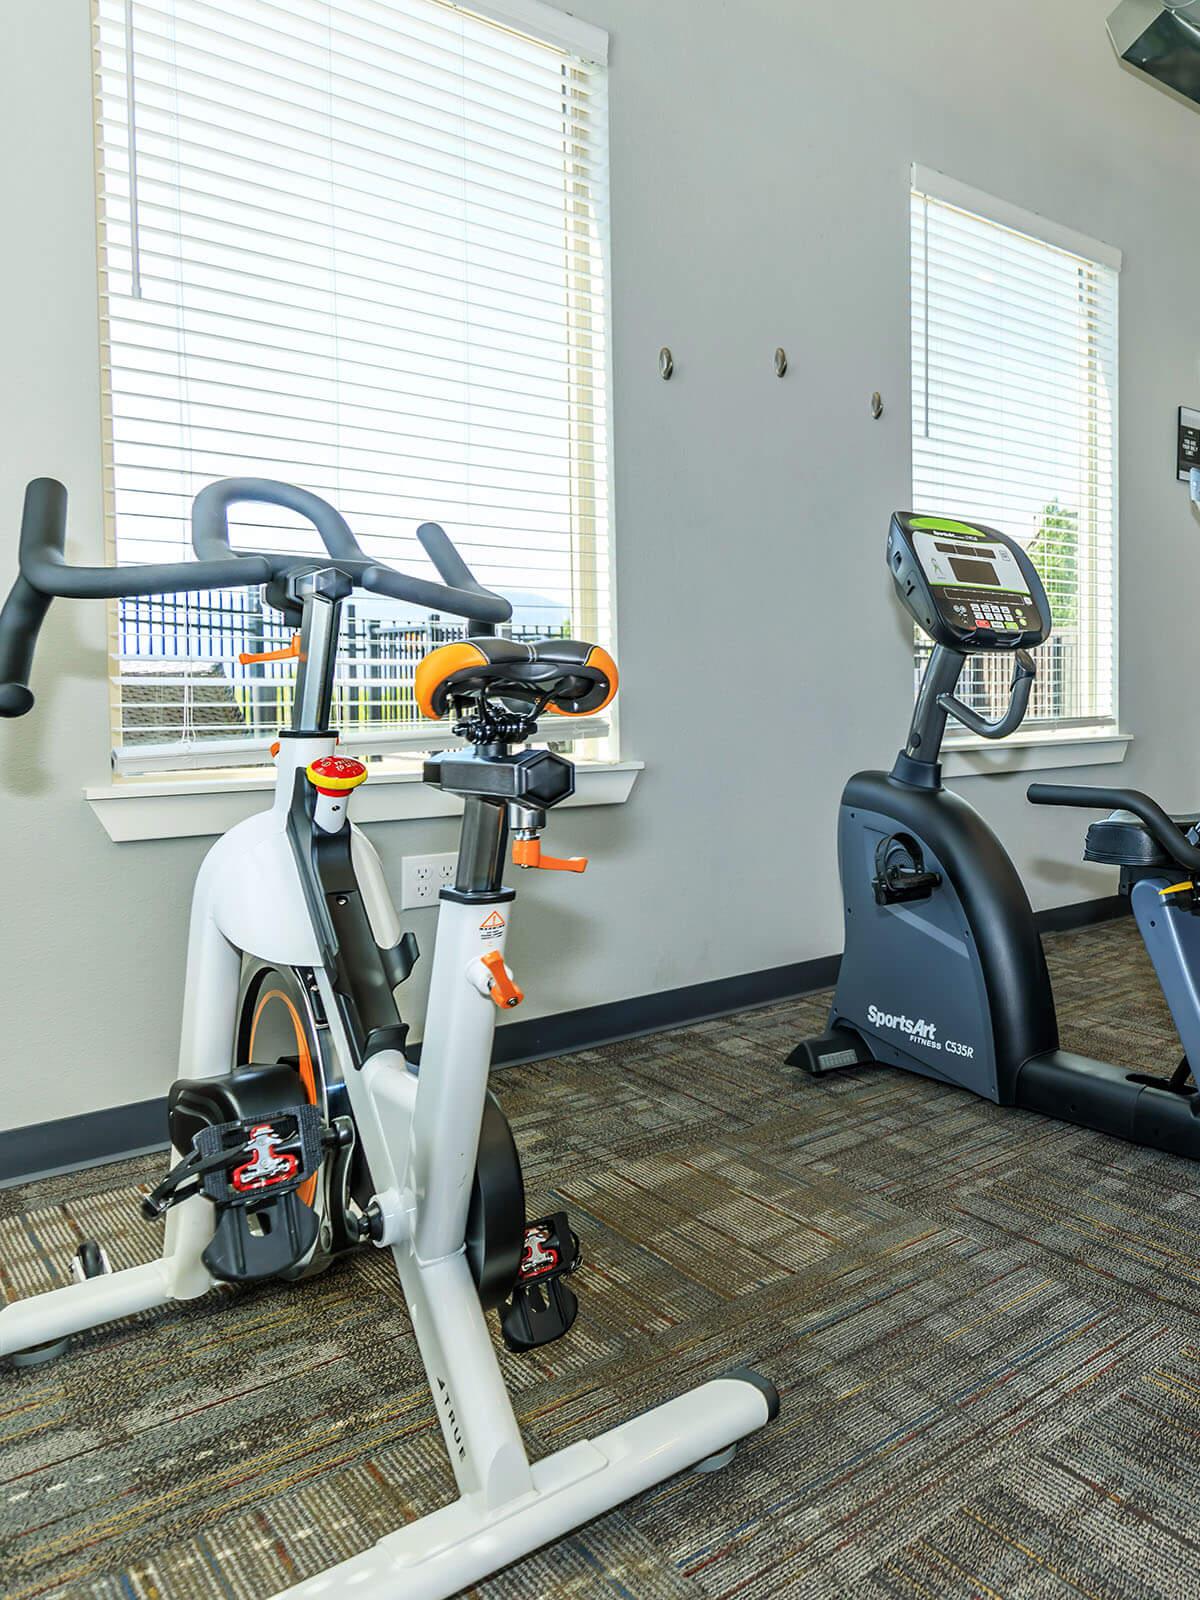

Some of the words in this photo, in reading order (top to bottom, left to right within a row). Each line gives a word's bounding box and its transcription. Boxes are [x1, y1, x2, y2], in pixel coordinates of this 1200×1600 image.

[867, 1004, 937, 1040] SportsArt
[909, 1034, 942, 1051] FITNESS
[944, 1039, 975, 1059] C535R
